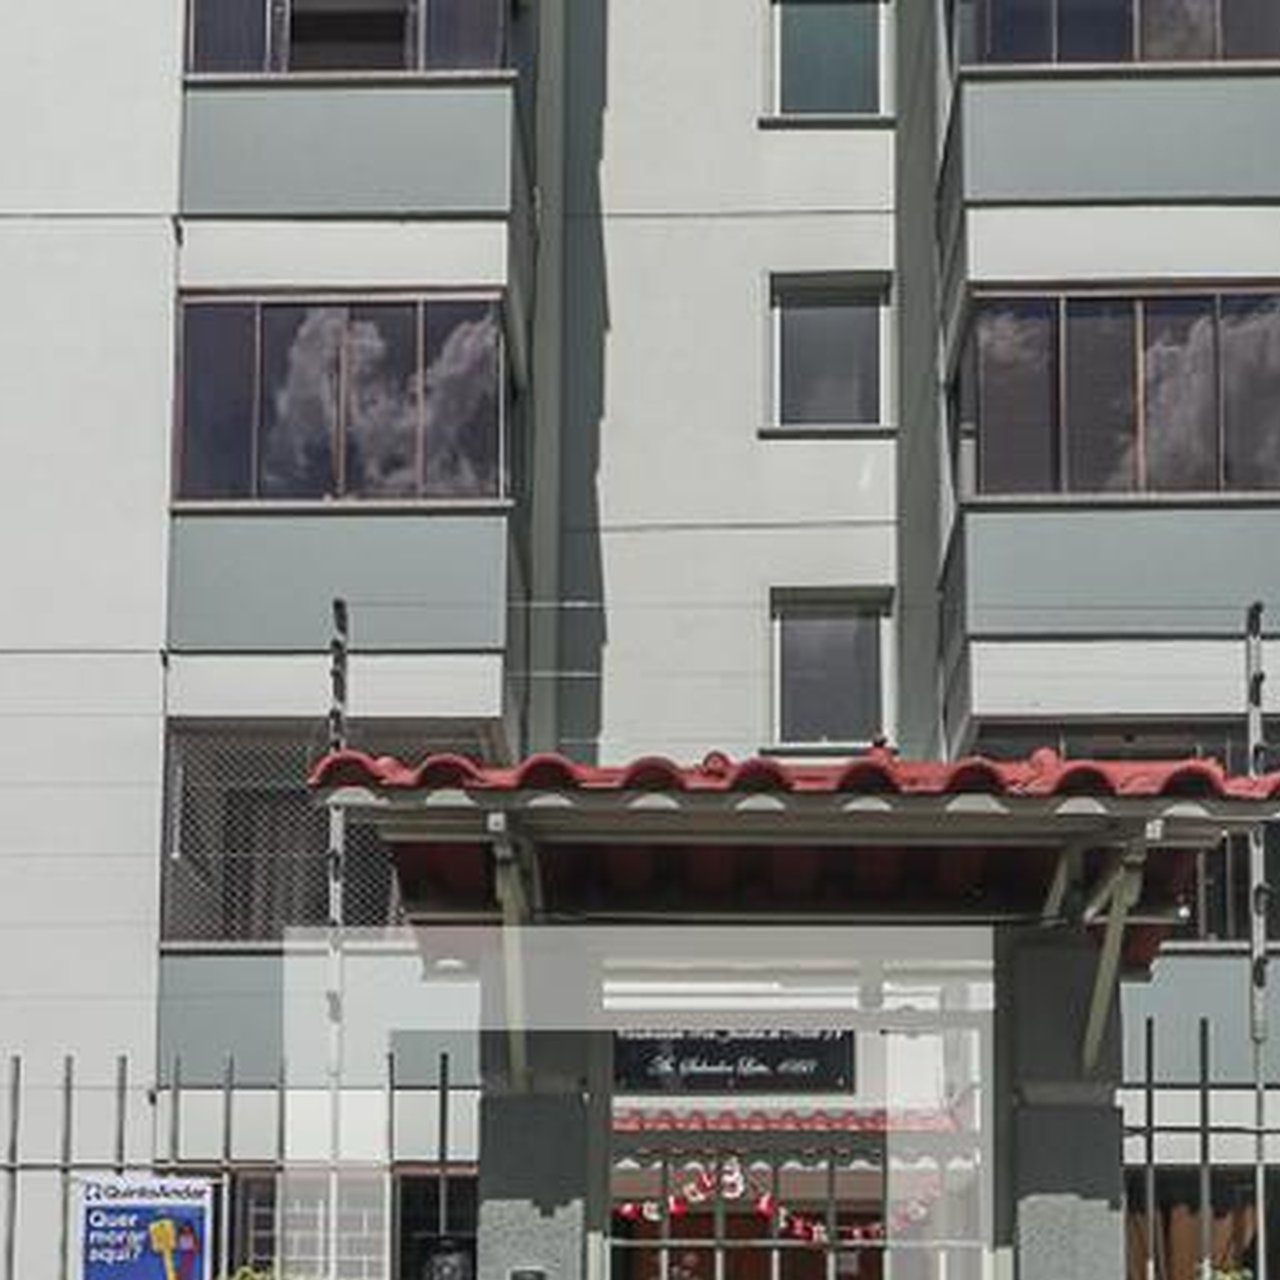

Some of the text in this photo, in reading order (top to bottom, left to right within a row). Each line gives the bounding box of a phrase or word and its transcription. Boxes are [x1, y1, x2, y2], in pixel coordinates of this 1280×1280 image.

[104, 1184, 207, 1200] QuintoAndar
[89, 1210, 139, 1228] Quer
[89, 1229, 147, 1245] morar
[89, 1244, 142, 1265] aqui?
